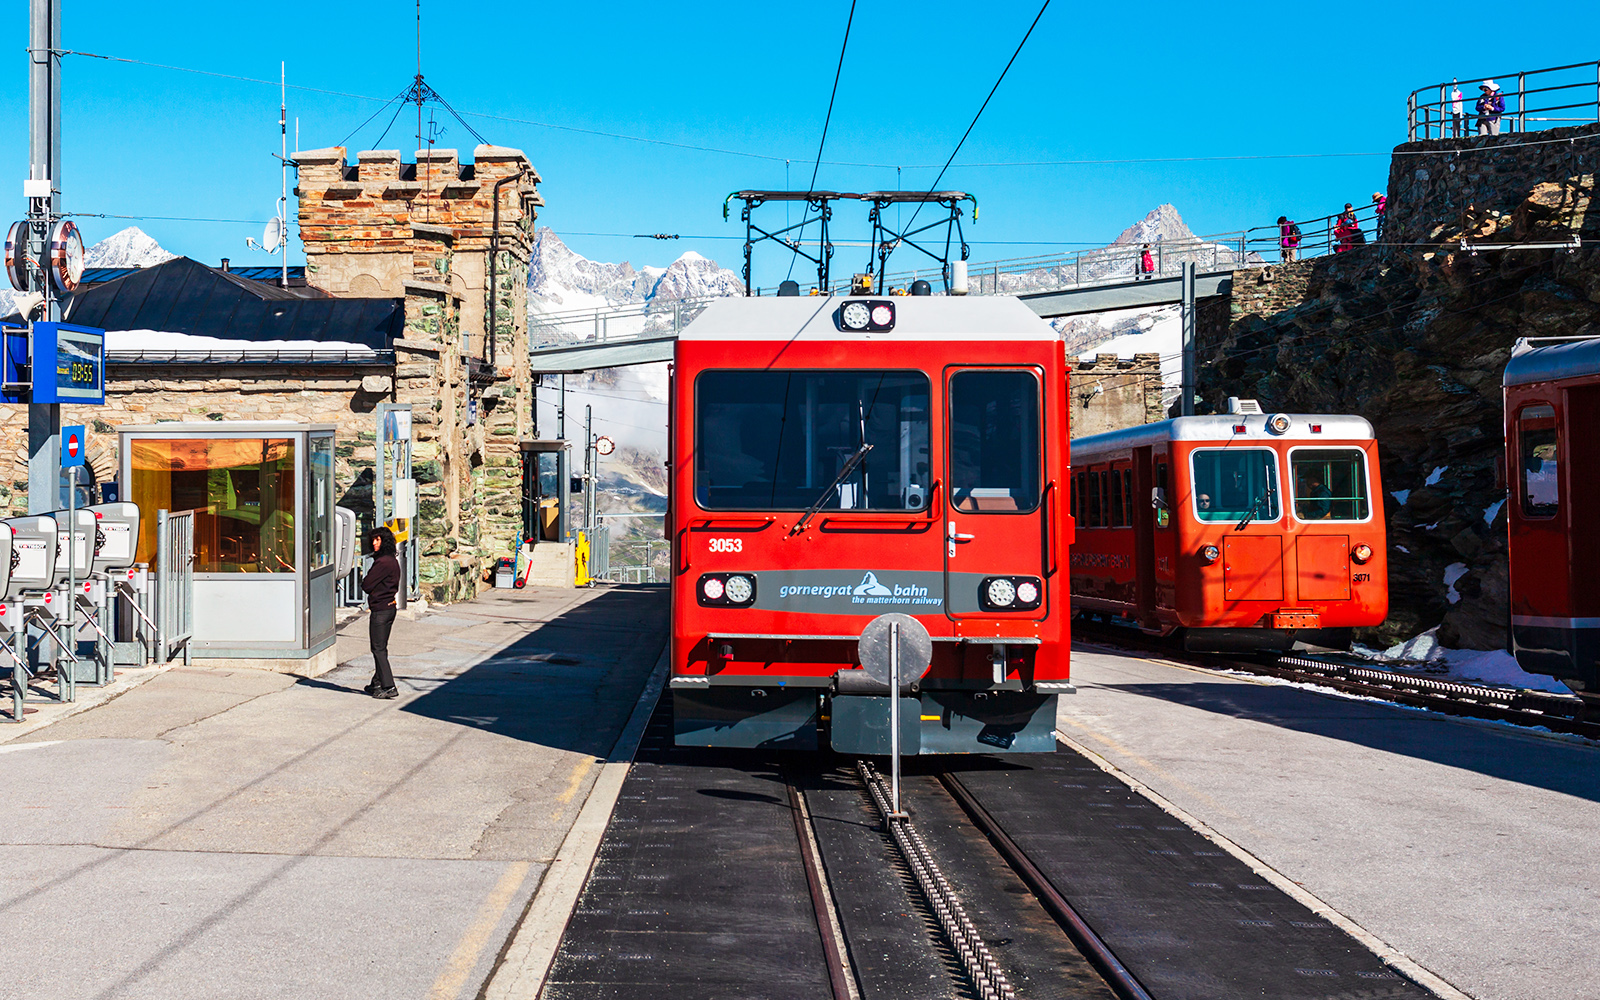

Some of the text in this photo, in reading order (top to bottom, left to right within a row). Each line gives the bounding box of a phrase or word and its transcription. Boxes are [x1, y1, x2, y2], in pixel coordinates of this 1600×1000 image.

[72, 363, 92, 381] 09:55
[708, 538, 743, 552] 3053
[1353, 573, 1370, 581] 3071
[779, 584, 928, 599] gornergrat bahn
[852, 596, 943, 606] the matterhorn railway
